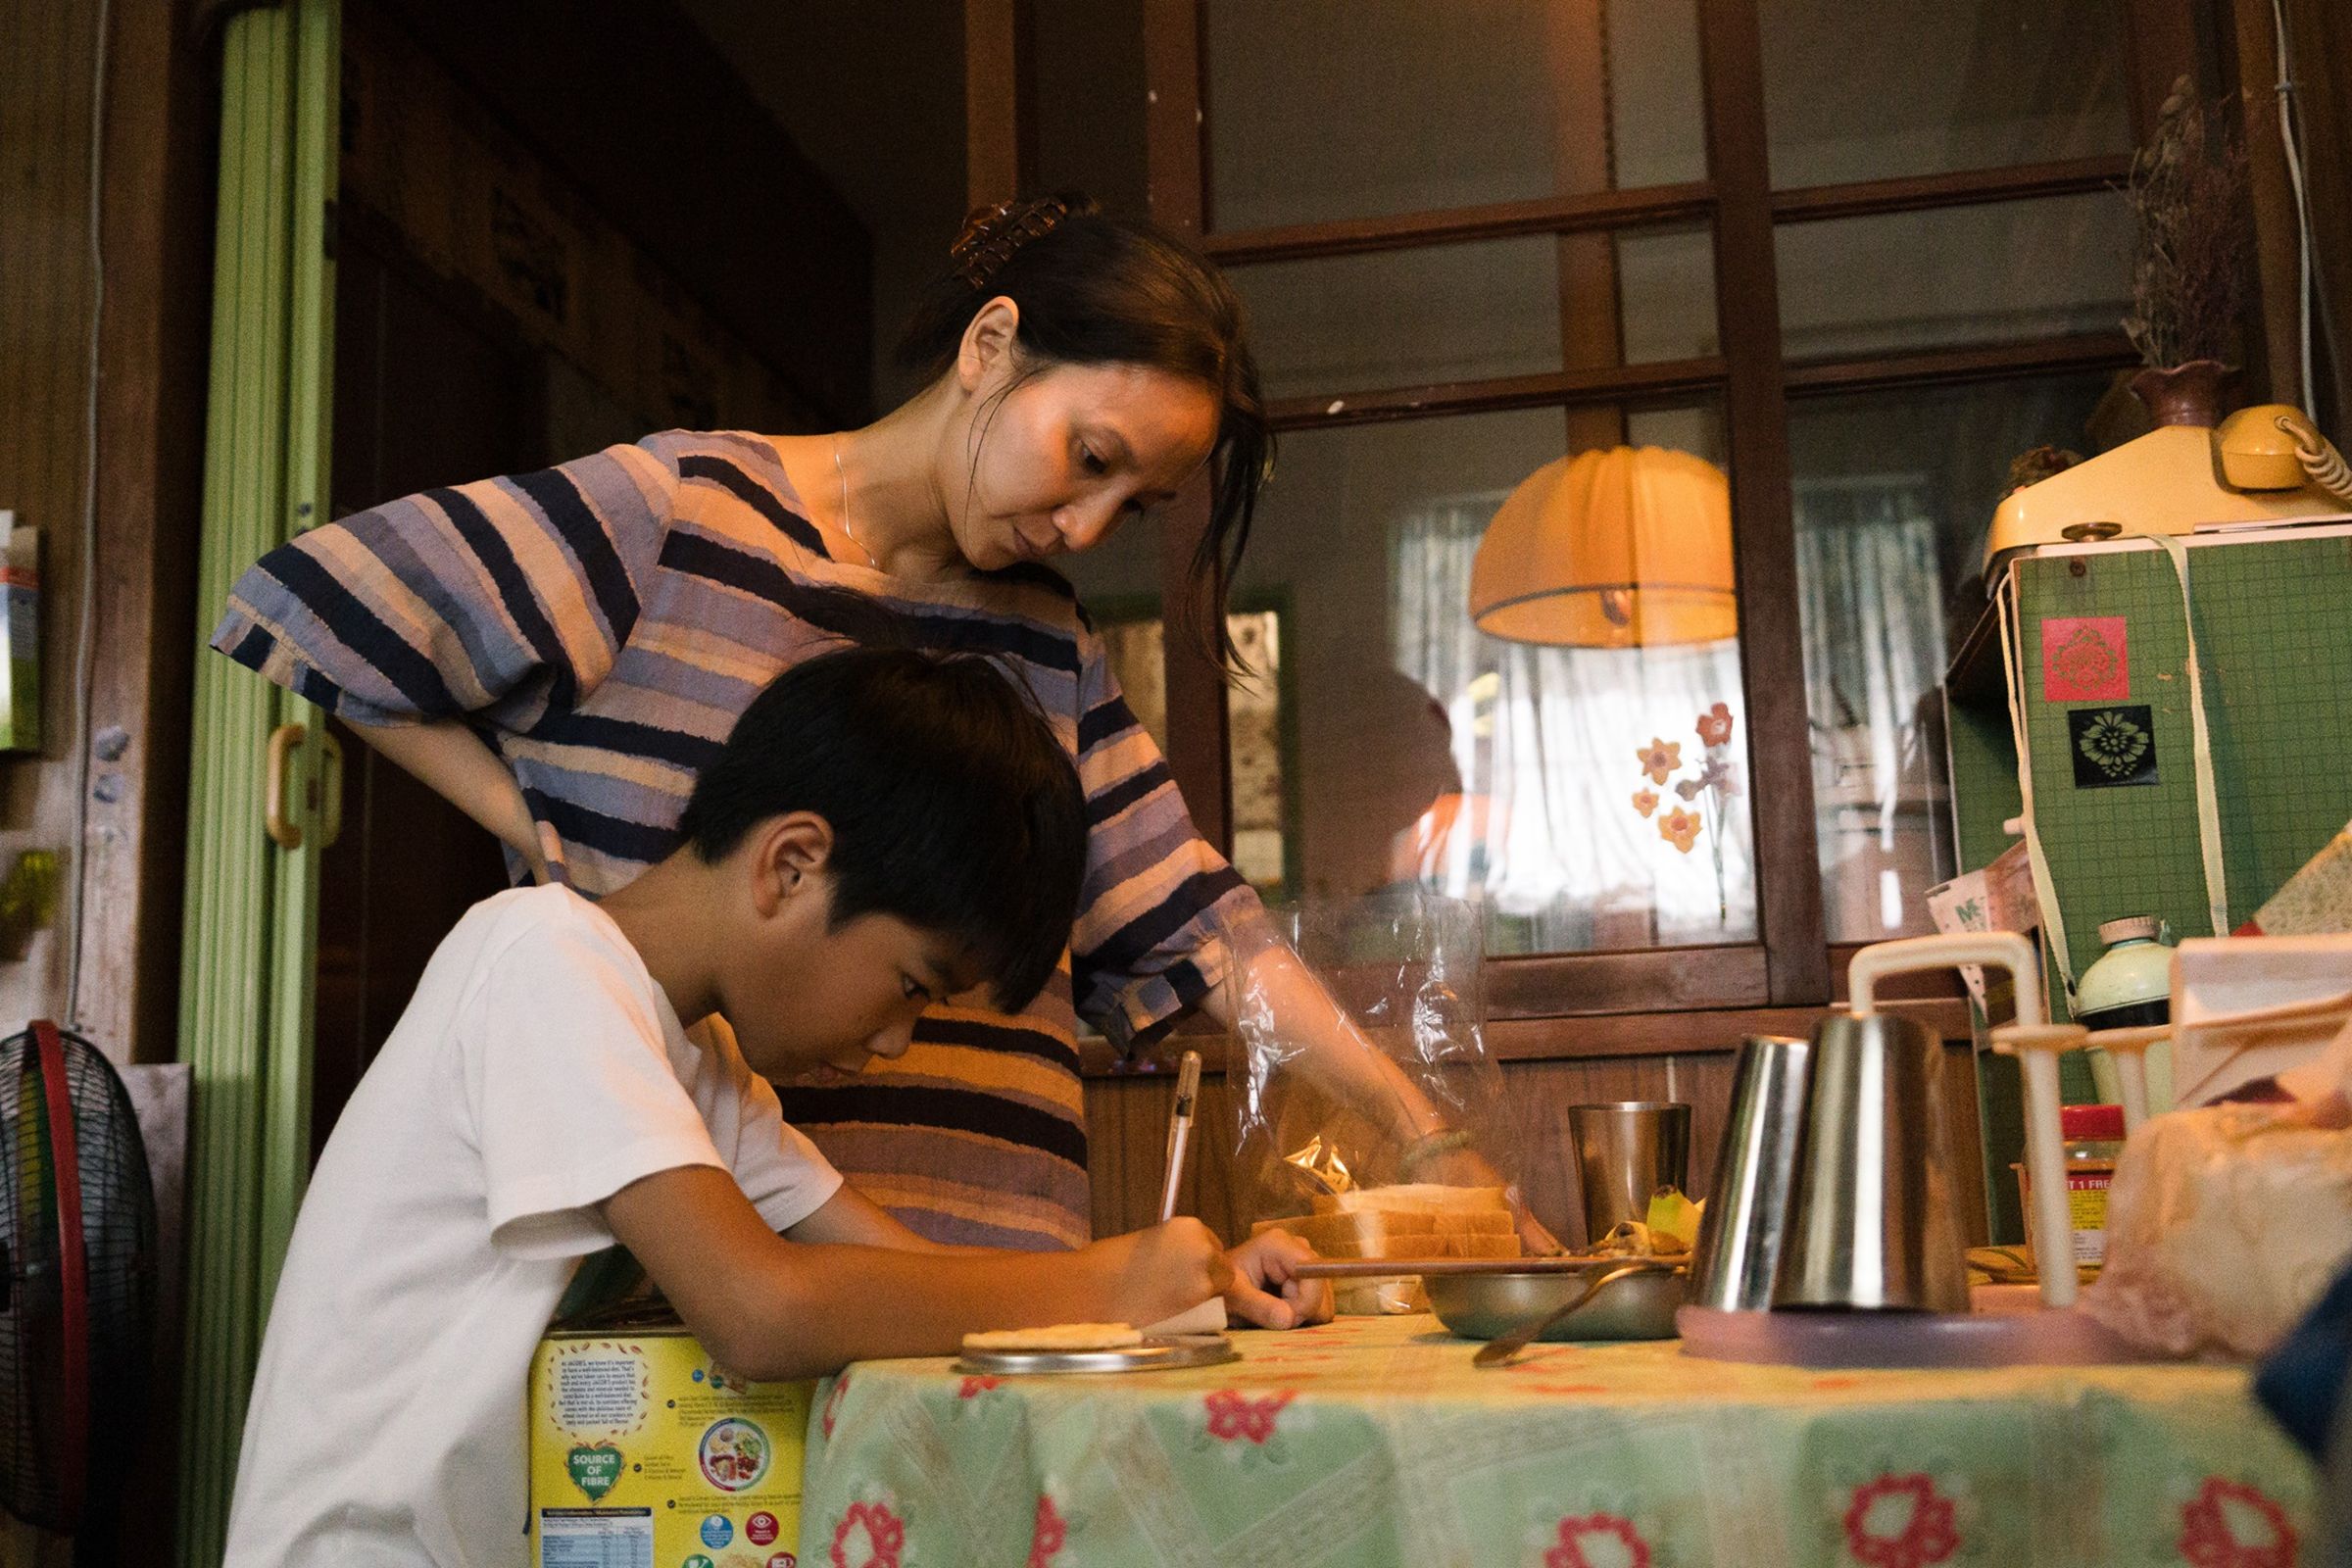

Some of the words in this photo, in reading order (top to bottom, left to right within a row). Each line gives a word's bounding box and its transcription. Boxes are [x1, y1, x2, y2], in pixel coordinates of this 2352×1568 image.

[2079, 1181, 2084, 1190] 1
[573, 1454, 614, 1464] SOURCE
[587, 1465, 602, 1475] OF
[581, 1476, 611, 1486] FIBRE
